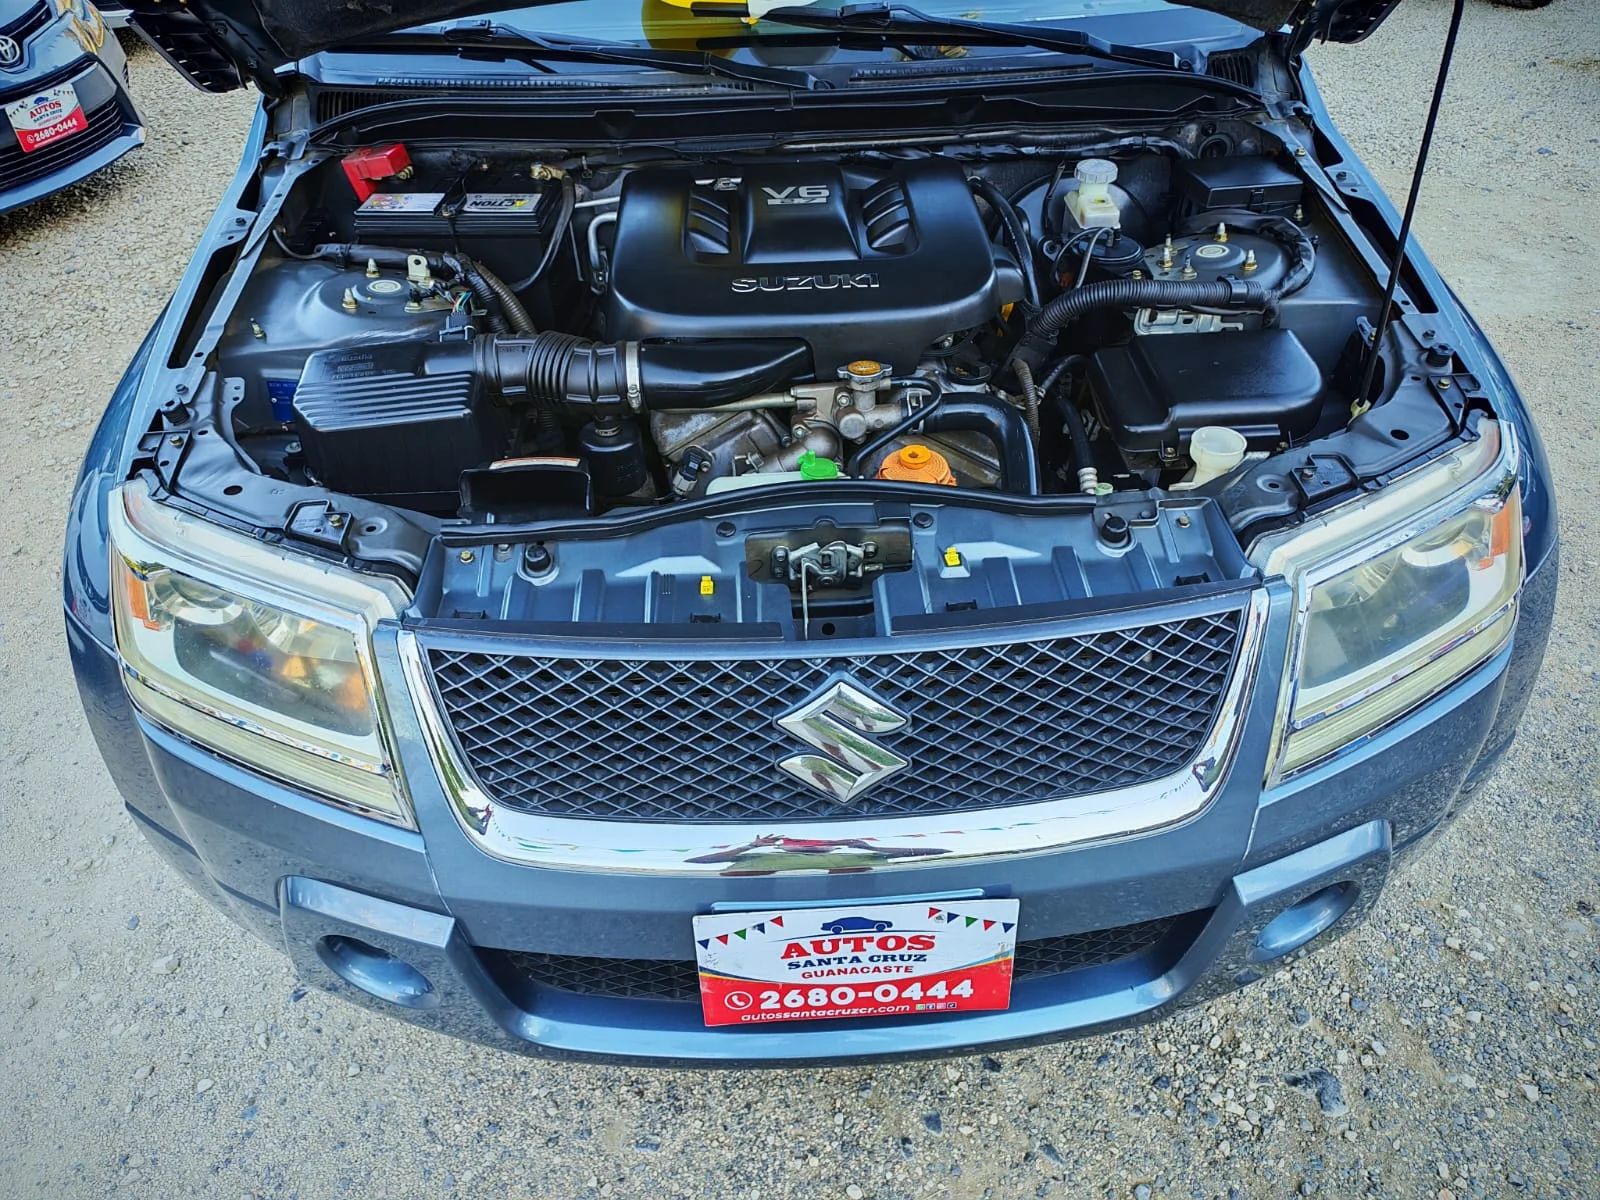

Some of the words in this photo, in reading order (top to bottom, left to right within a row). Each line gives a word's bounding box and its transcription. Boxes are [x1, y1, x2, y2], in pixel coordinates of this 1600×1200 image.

[30, 100, 62, 119] AUTOS
[34, 118, 78, 142] 2680-0444
[761, 184, 830, 199] V6
[469, 198, 528, 208] ACTION
[731, 272, 880, 293] SUZUKI
[780, 934, 936, 960] AUTOS
[787, 955, 863, 970] SANTA
[868, 953, 927, 963] CRUZ
[801, 965, 914, 979] GUANACASTE
[759, 979, 974, 1010] 2680-0444
[741, 1003, 910, 1021] autossantacruzcr.com
